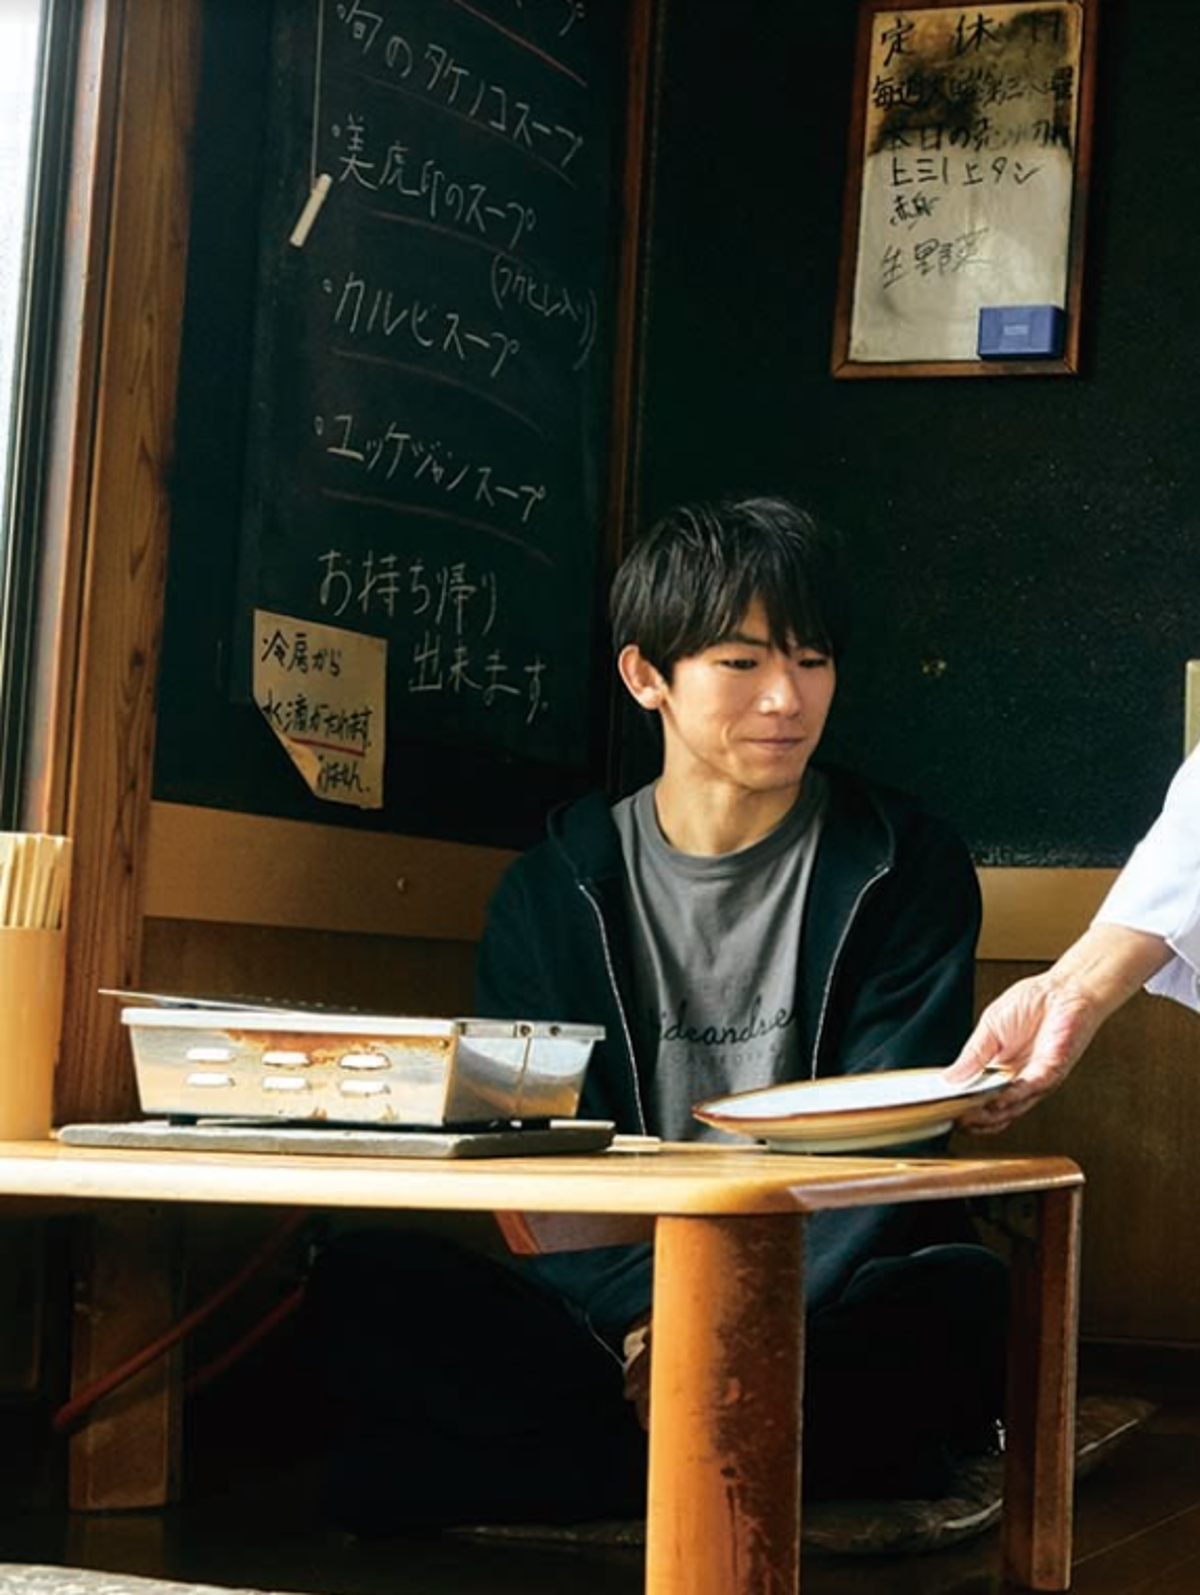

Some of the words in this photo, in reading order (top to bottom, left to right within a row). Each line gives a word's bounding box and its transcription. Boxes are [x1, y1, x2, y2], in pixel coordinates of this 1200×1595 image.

[334, 272, 520, 377] カルビスープ
[318, 550, 498, 635] お持ち帰り
